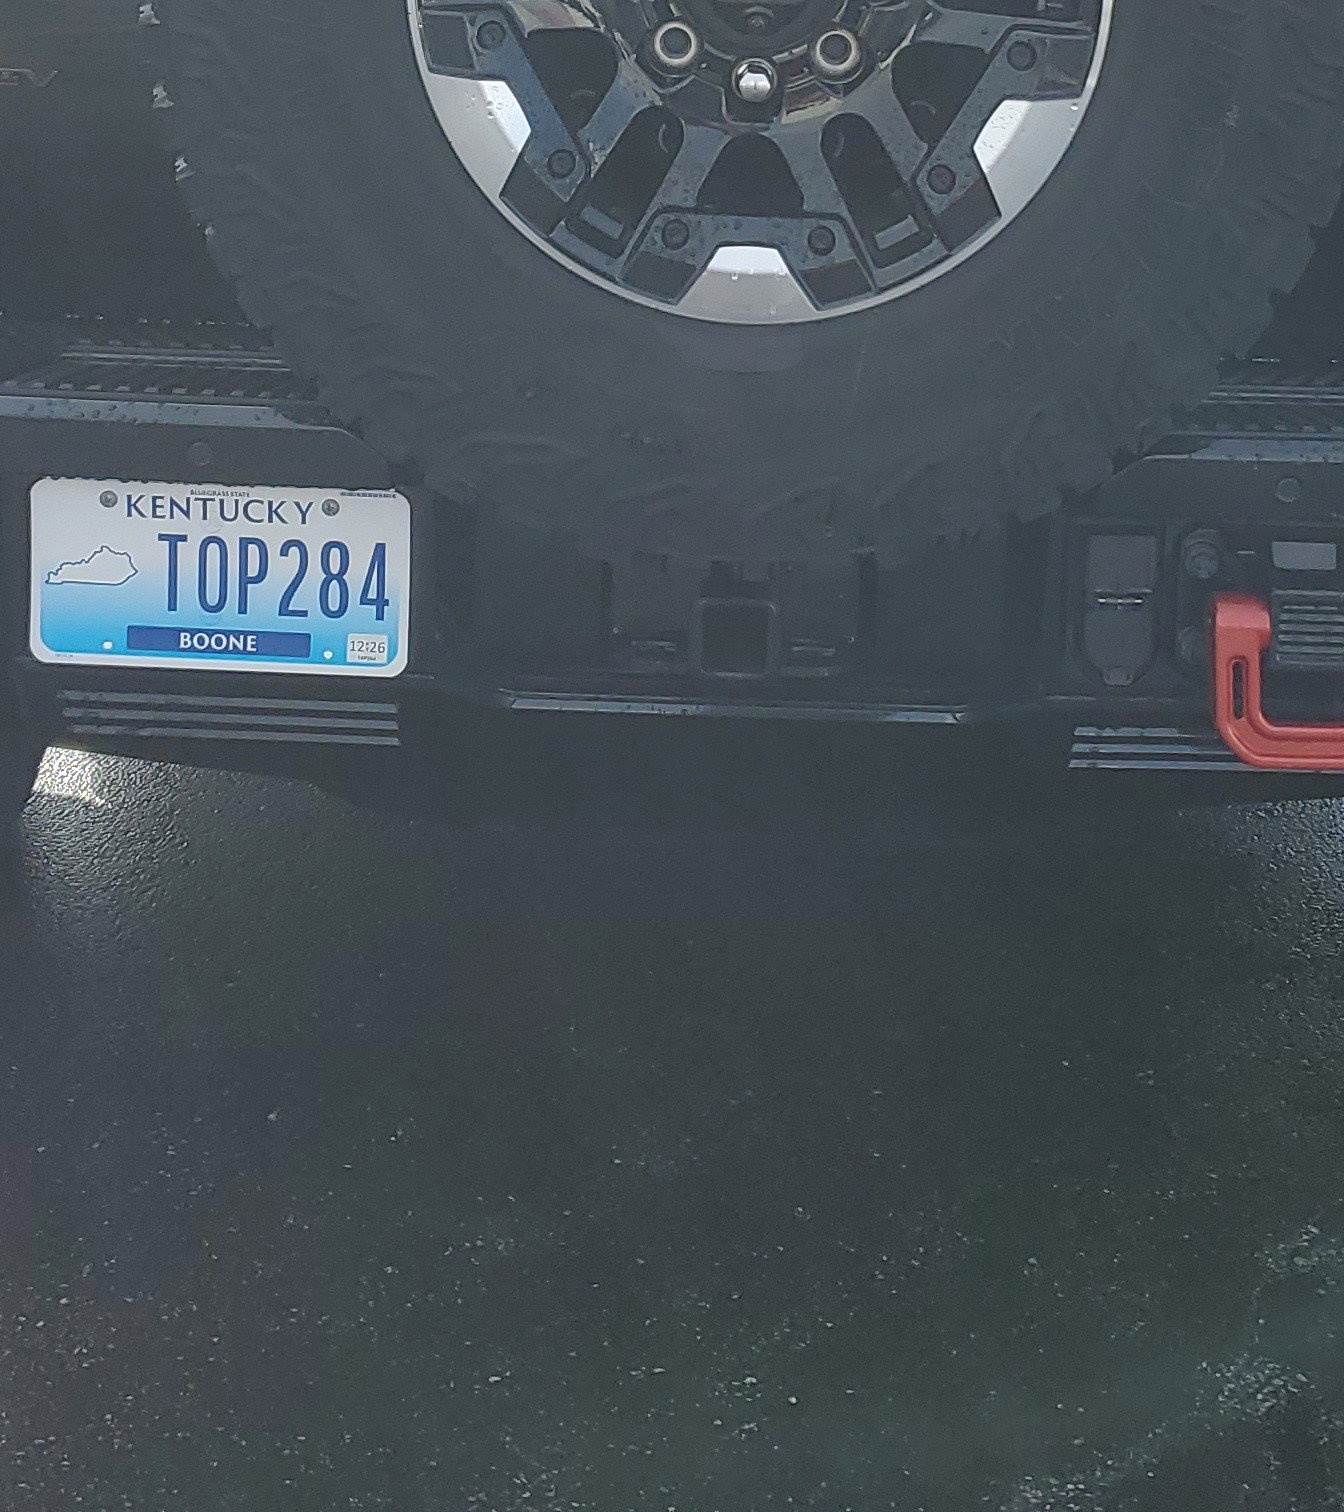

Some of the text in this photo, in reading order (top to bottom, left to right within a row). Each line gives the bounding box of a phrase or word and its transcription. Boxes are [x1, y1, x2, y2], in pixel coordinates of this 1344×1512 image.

[190, 489, 230, 497] BLUEGRASS
[126, 493, 314, 525] KENTUCKY
[158, 533, 390, 621] TOP284
[179, 632, 258, 652] BOONE
